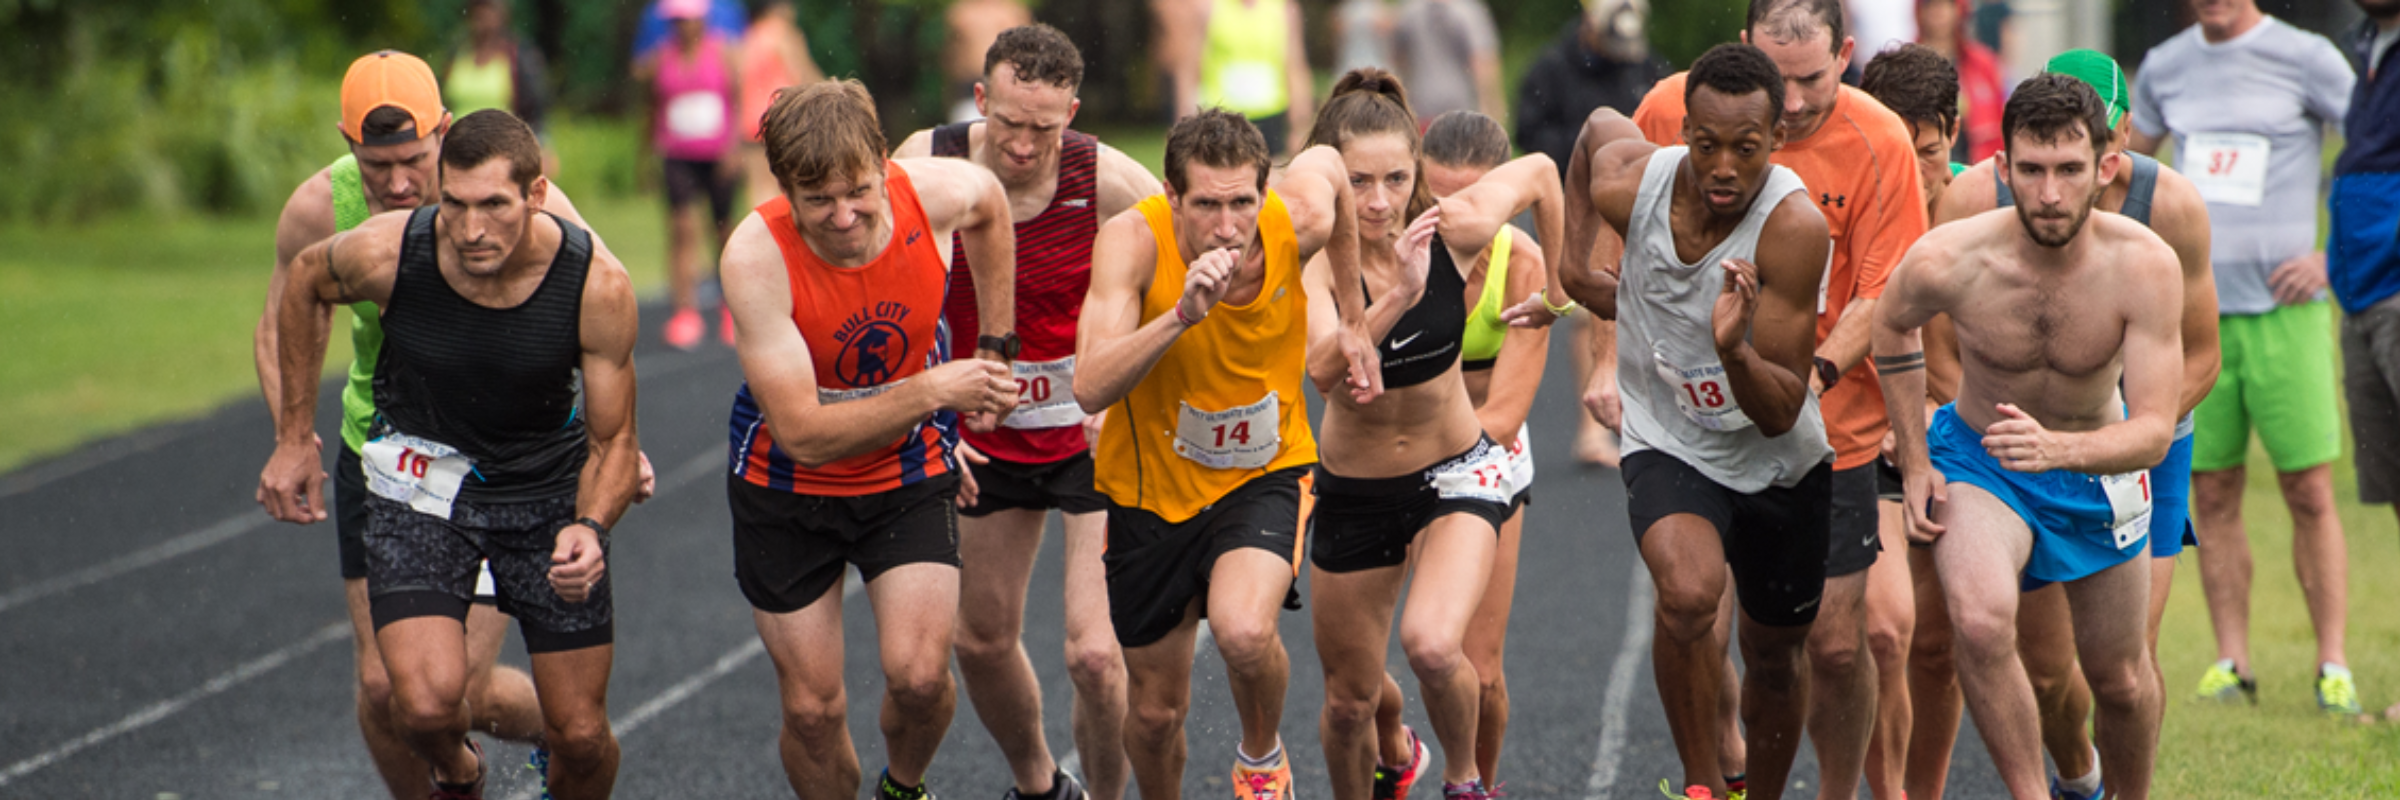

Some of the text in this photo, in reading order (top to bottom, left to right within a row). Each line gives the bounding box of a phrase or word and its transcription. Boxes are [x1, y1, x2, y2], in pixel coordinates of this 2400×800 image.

[2208, 150, 2239, 176] 37
[833, 301, 911, 342] BULL CITY
[1014, 375, 1051, 404] 20
[1682, 381, 1725, 408] 13
[1211, 420, 1250, 447] 14
[397, 446, 432, 478] 16
[1474, 465, 1503, 489] 17
